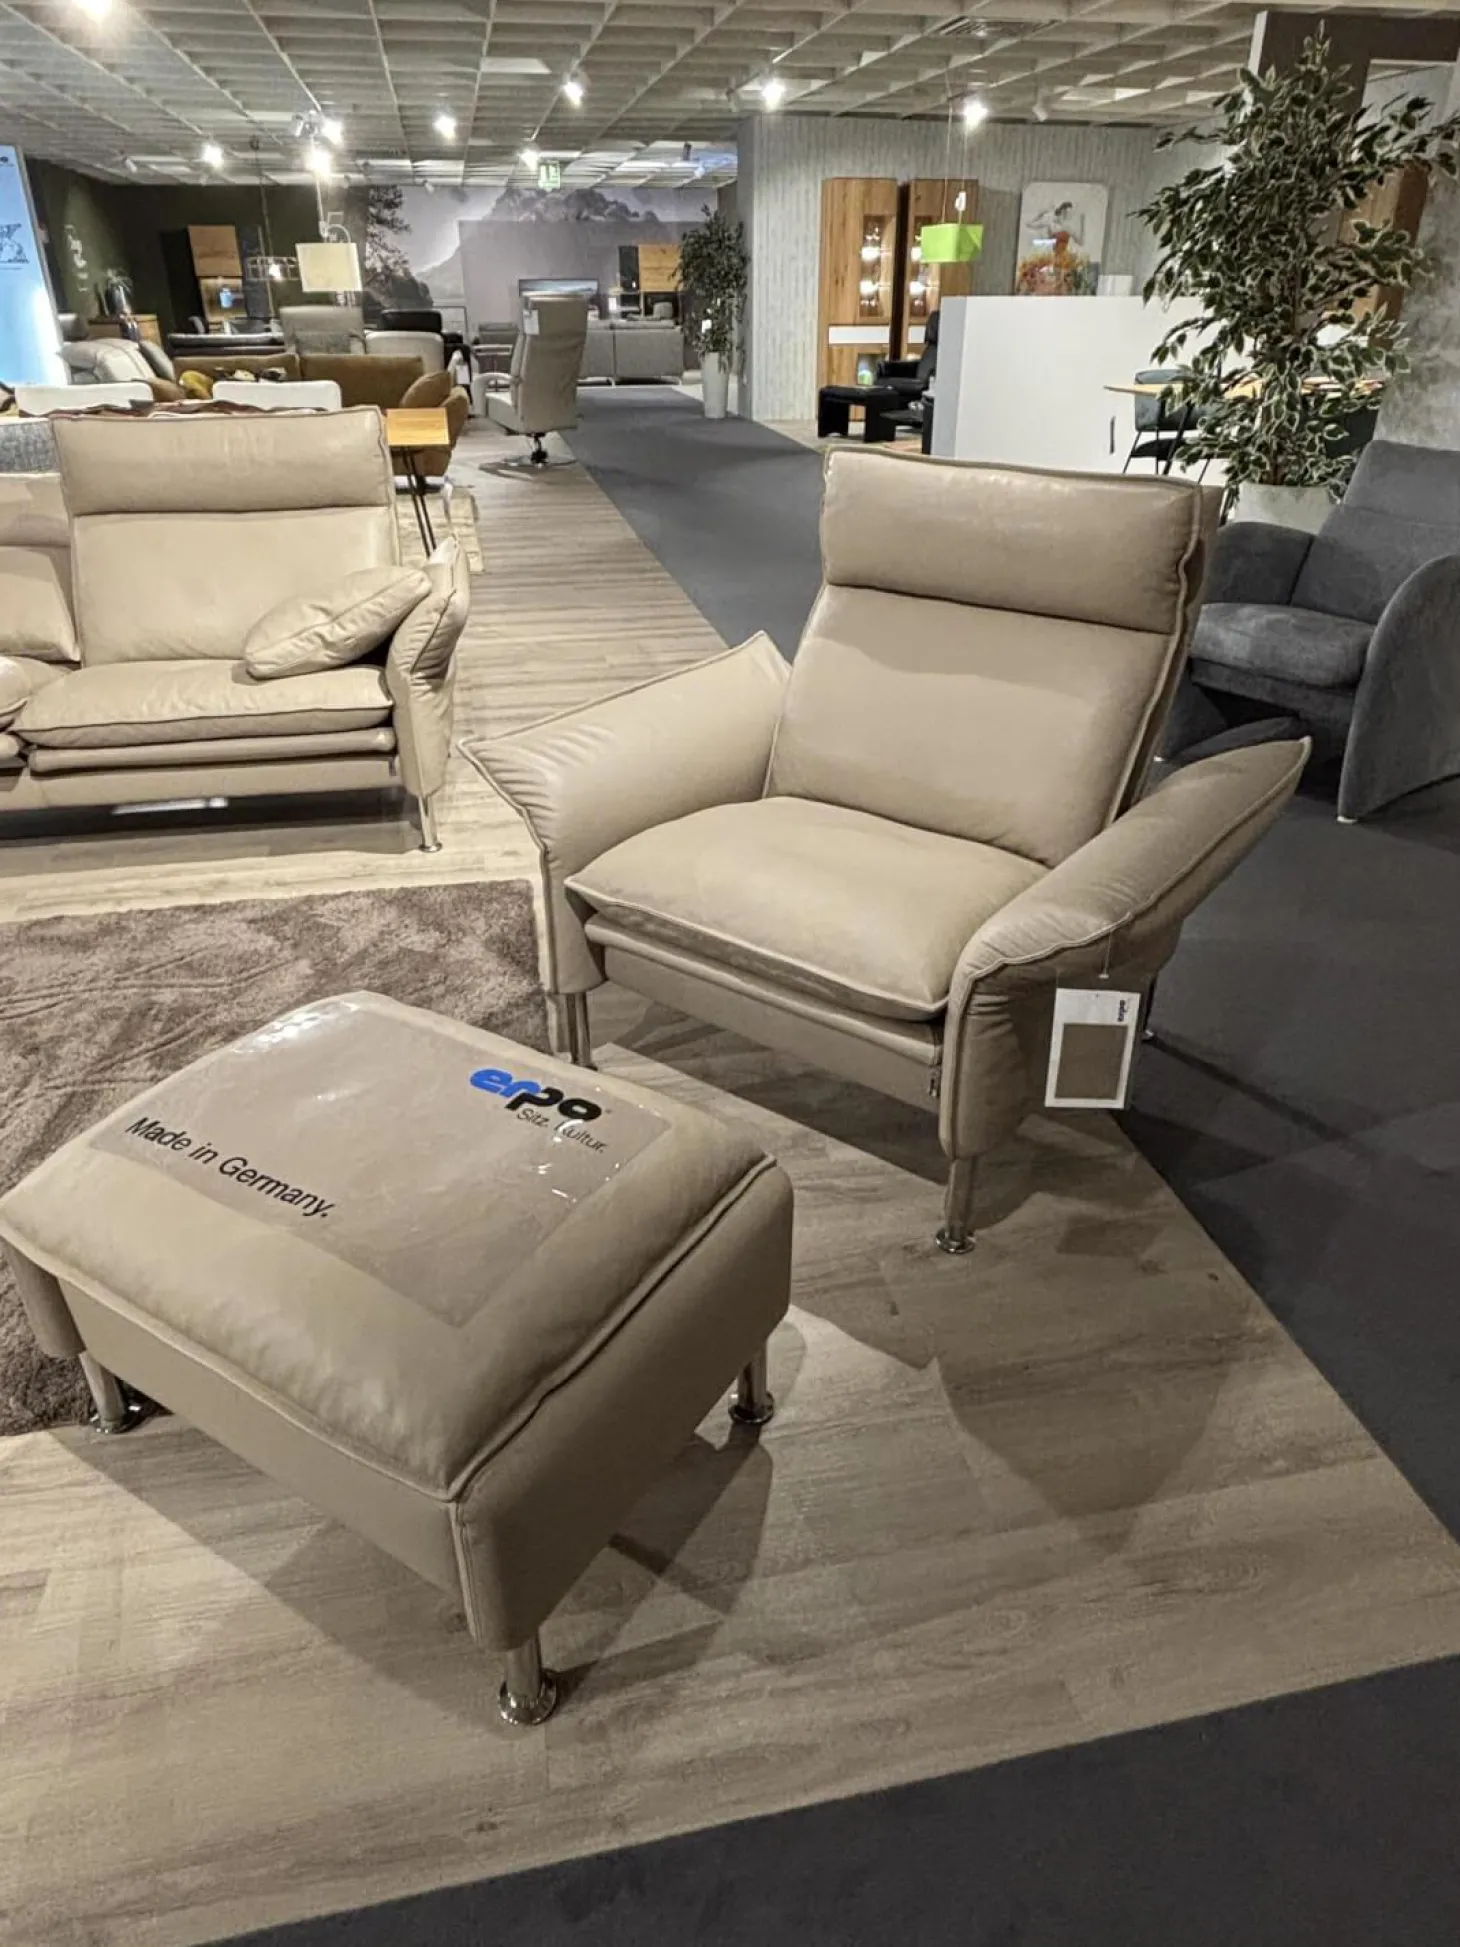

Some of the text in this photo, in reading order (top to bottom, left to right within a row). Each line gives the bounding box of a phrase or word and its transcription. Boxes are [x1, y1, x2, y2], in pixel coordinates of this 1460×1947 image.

[470, 1069, 602, 1122] erpo
[124, 1116, 335, 1218] Made in Germany.
